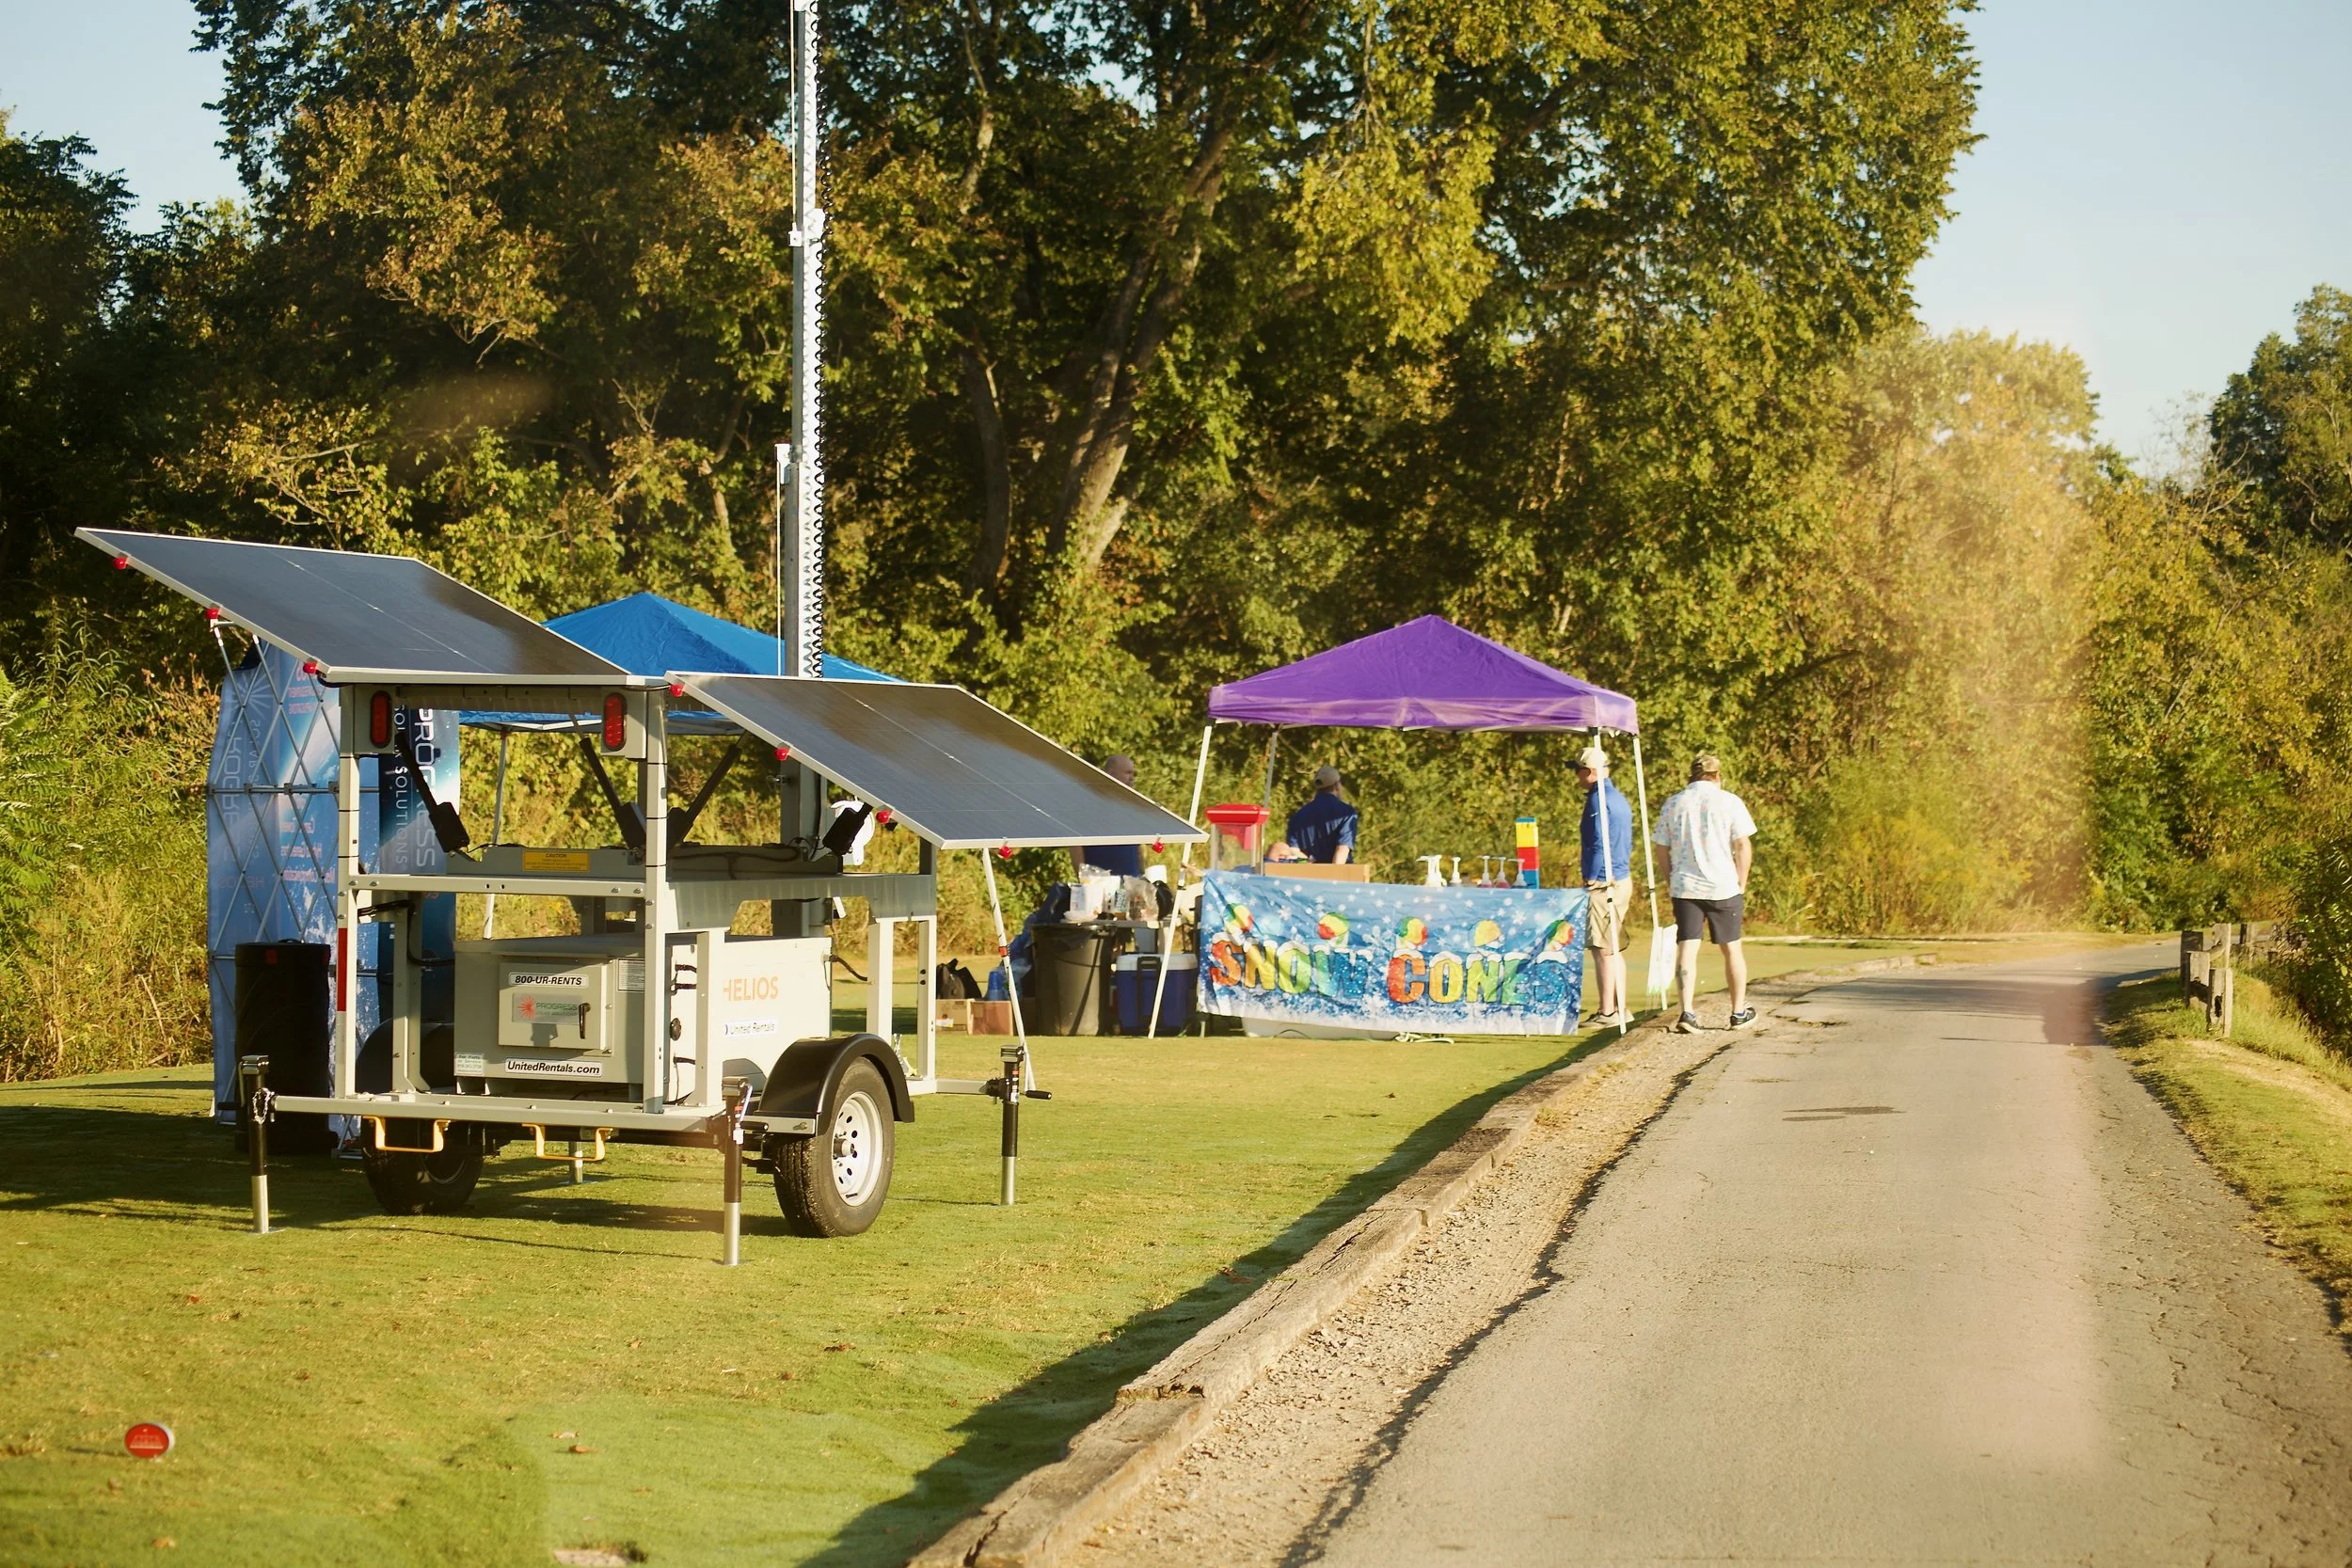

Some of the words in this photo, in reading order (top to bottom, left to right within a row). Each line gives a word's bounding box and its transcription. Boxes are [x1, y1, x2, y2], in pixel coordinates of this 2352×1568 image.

[1209, 932, 1374, 1000] SNOW
[1387, 947, 1569, 1006] CONES
[515, 975, 582, 985] 800-UR-RENTS
[535, 1002, 578, 1011] PROGRESS
[730, 1023, 751, 1035] United
[753, 1022, 775, 1033] Rentals
[507, 1061, 600, 1074] UnitedRentals.com
